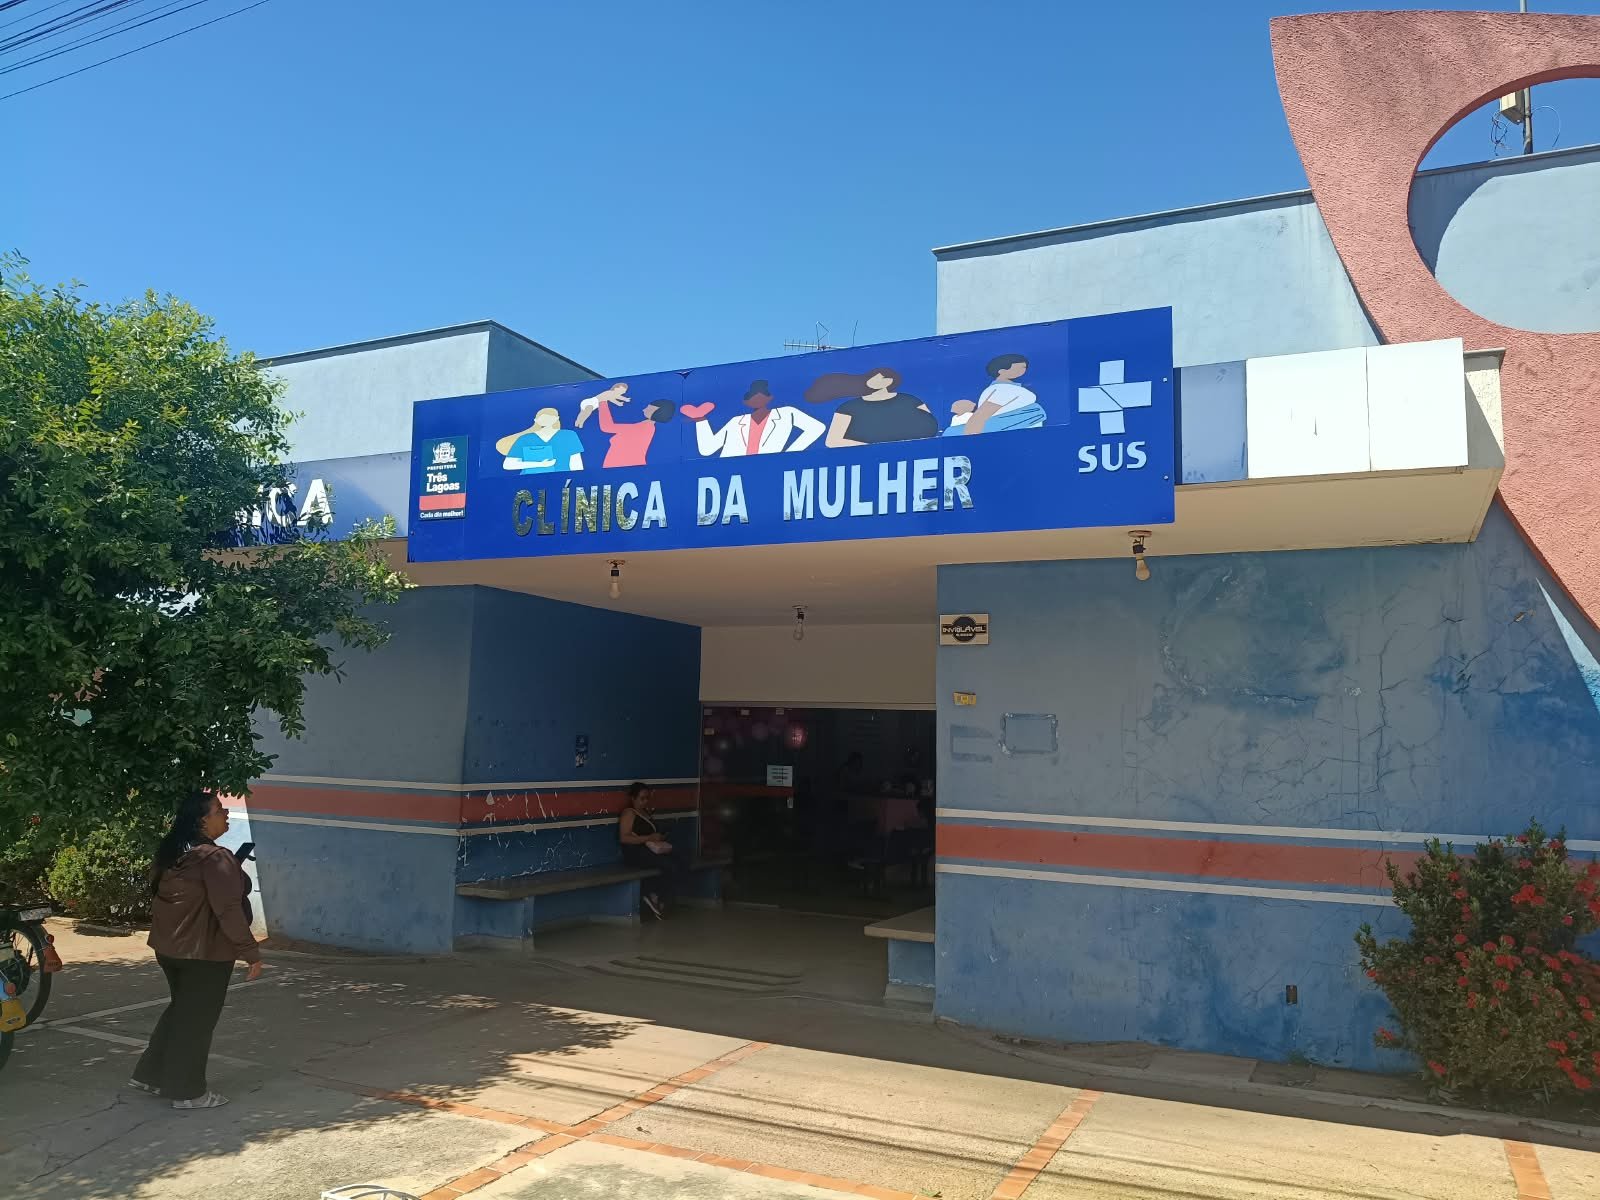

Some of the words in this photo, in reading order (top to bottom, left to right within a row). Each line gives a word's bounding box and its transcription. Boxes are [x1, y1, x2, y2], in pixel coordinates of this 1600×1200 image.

[1078, 440, 1147, 473] SUS
[426, 473, 448, 483] Três
[426, 482, 460, 493] Lagoas
[512, 479, 668, 537] CLÍNICA
[697, 474, 749, 526] DA
[783, 455, 974, 521] MULHER
